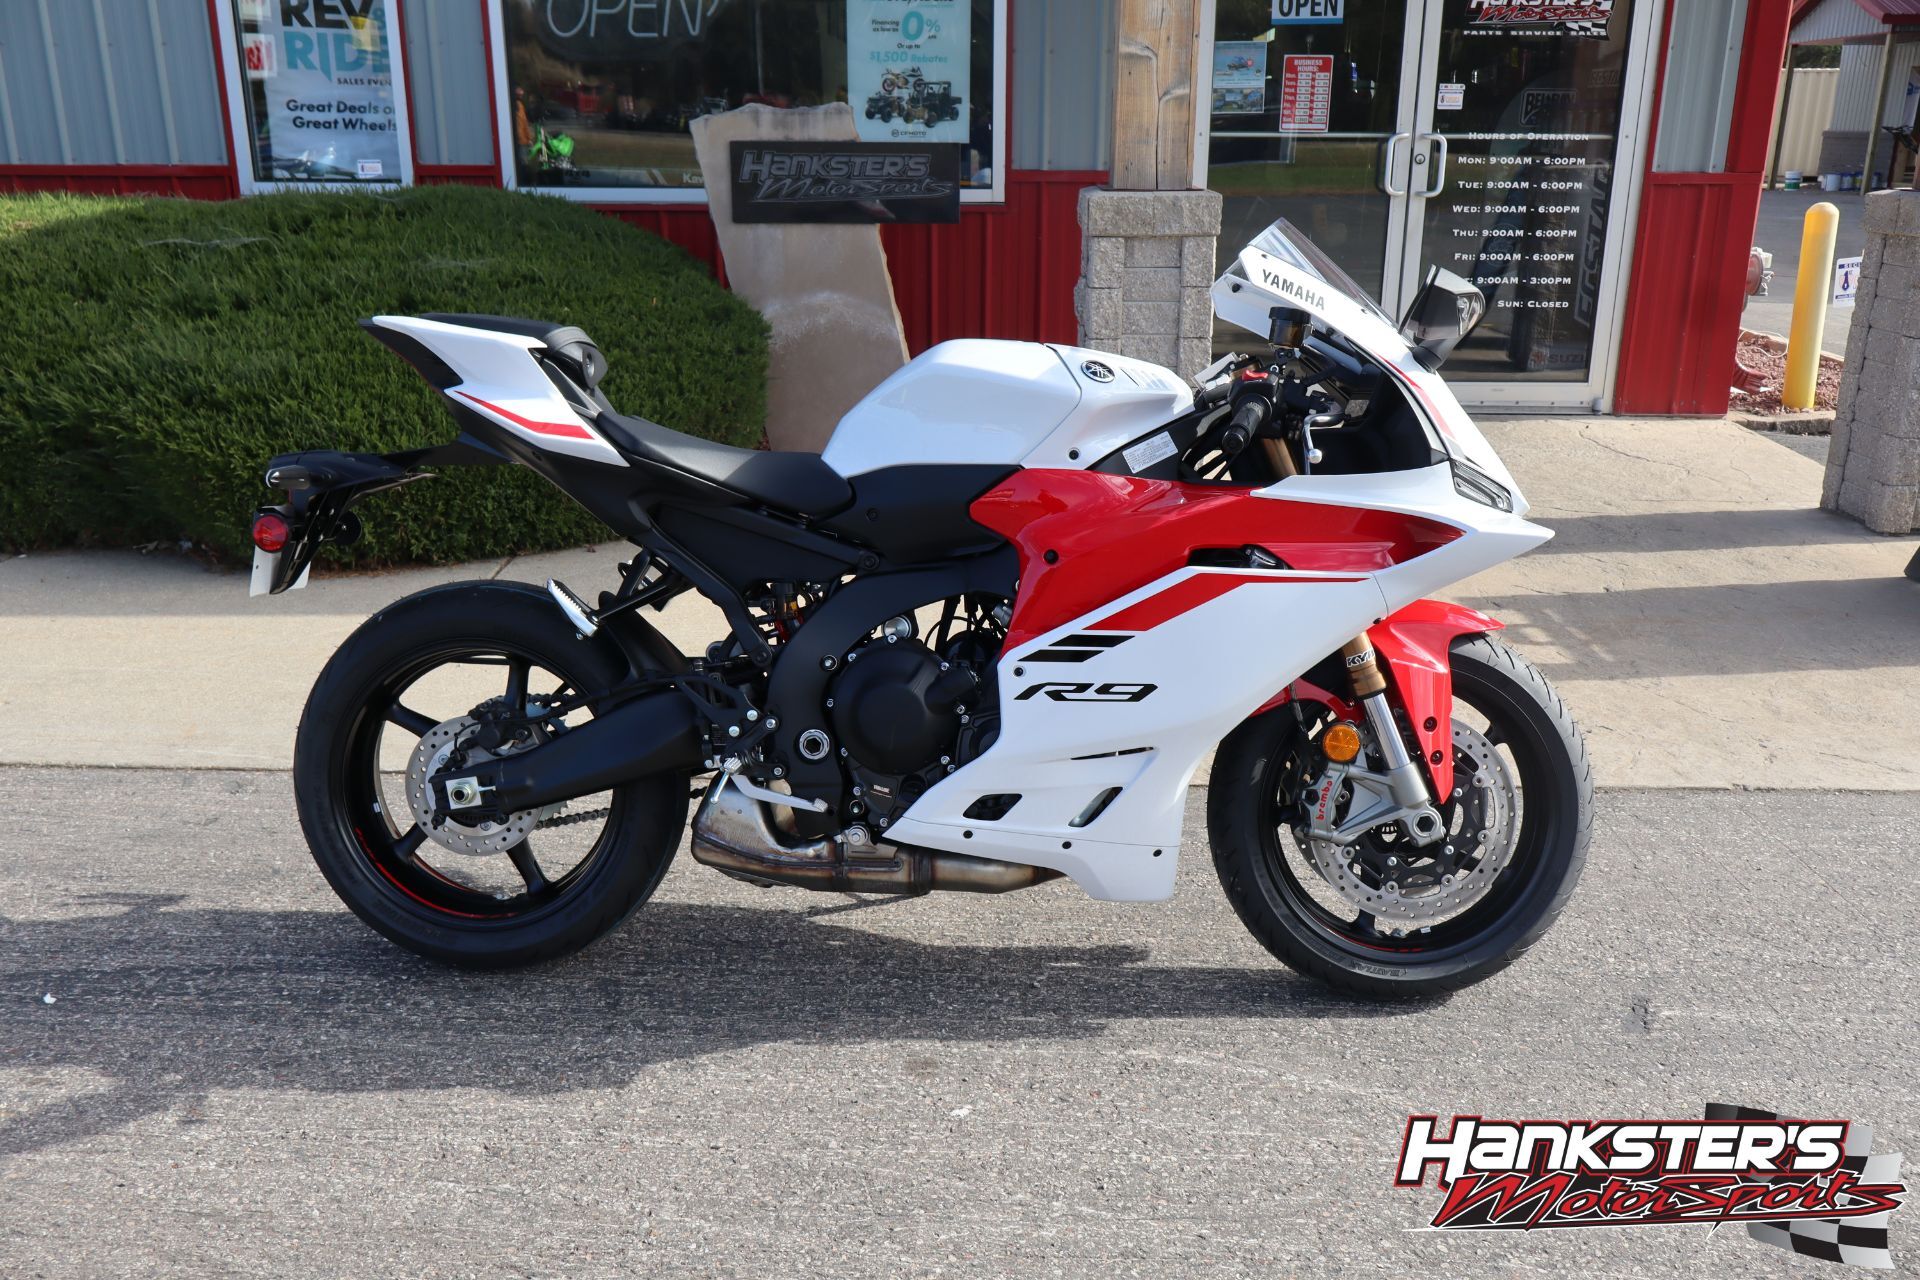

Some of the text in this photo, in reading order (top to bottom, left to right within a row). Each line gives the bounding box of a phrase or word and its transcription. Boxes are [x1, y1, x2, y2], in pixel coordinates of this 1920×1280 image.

[280, 0, 374, 29] REV
[1279, 0, 1338, 16] OPEN
[547, 0, 703, 37] OPEN
[284, 31, 391, 82] RIDE
[870, 51, 948, 63] $1,500 Rebates
[337, 77, 364, 86] SALES
[286, 99, 395, 115] Great Deals o
[292, 116, 397, 132] Great Wheels
[1489, 157, 1532, 165] 9:00AM
[1543, 157, 1586, 166] 6:00PM
[1486, 181, 1529, 189] 9:00AM
[1541, 181, 1583, 190] 6:00PM
[1484, 205, 1527, 214] 9:00AM
[1538, 205, 1580, 214] 6:00PM
[1481, 229, 1524, 237] 9:00AM
[1535, 229, 1577, 238] 6:00PM
[1479, 253, 1522, 261] 9:00AM
[1532, 253, 1575, 261] 6:00PM
[1477, 276, 1519, 285] 9:00AM
[1530, 276, 1572, 285] 3:00PM
[1262, 268, 1325, 310] YAMAHA
[1013, 682, 1159, 702] R9
[1316, 780, 1333, 820] brembo
